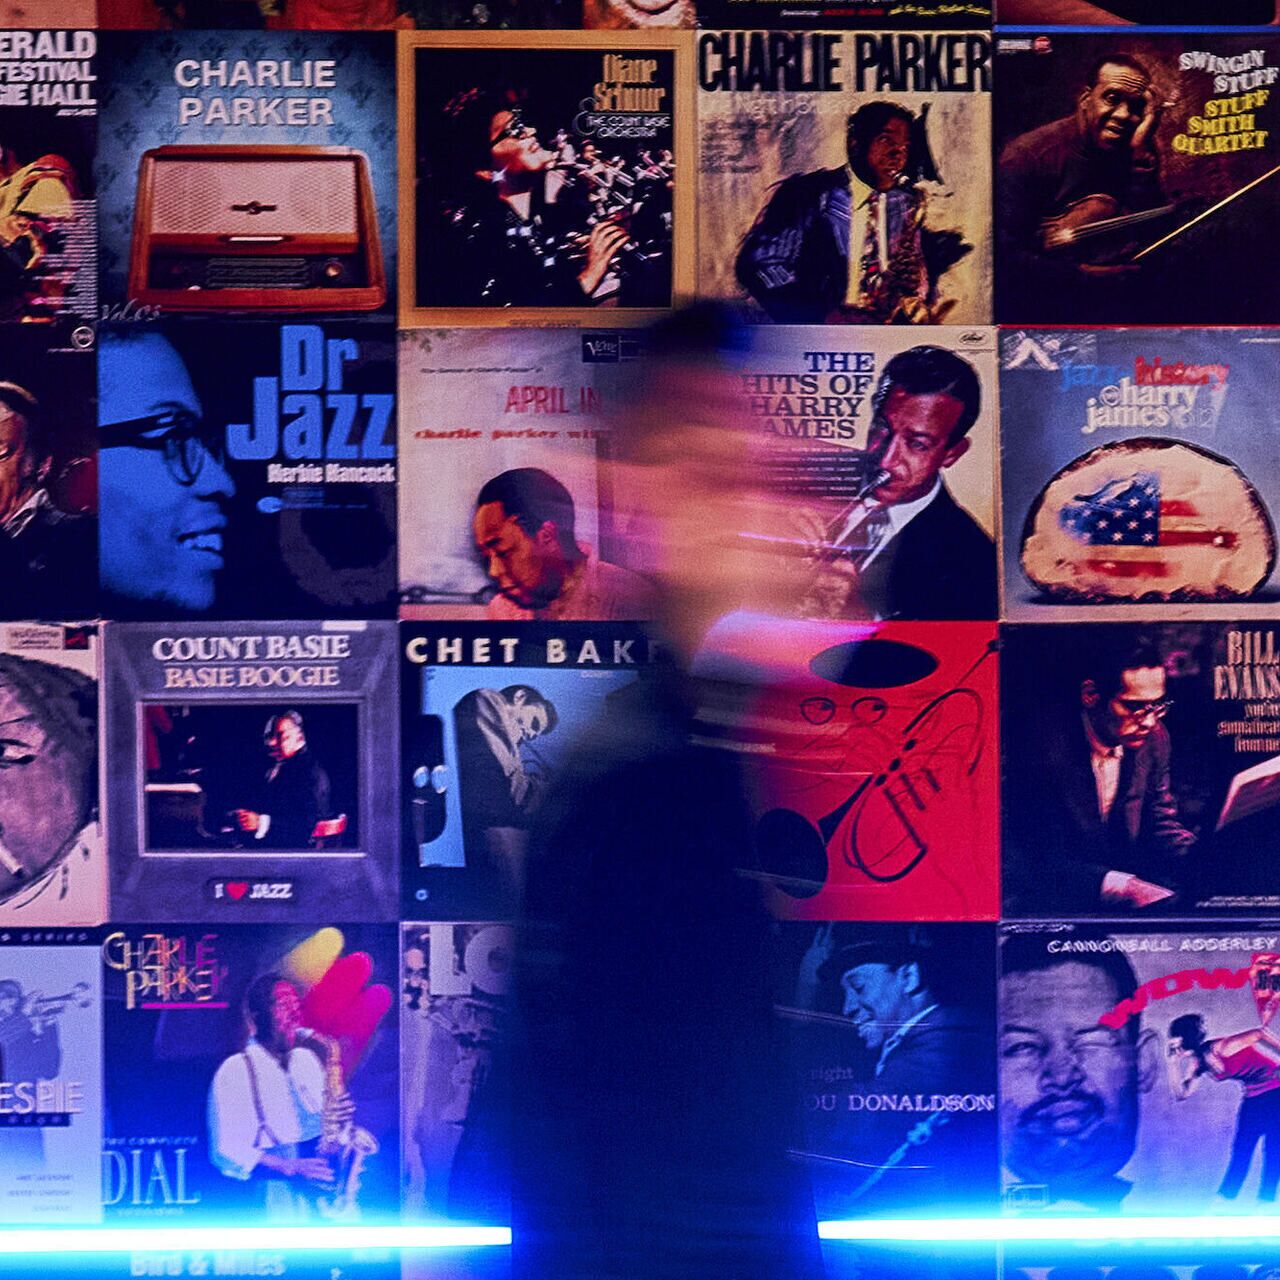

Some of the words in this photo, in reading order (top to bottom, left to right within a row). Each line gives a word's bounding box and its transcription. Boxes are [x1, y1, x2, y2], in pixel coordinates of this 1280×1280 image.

[175, 60, 336, 90] CHARLIE
[699, 33, 842, 92] CHARLIE
[855, 33, 992, 92] PARKER
[1213, 67, 1280, 94] STUFF
[31, 84, 97, 106] HALL
[1204, 90, 1270, 117] STUFF
[179, 97, 336, 126] PARKER
[1187, 114, 1256, 136] SMITH
[1171, 131, 1269, 157] QUARTET
[281, 325, 358, 391] Dr
[803, 352, 875, 373] THE
[741, 374, 819, 395] HITS
[828, 374, 874, 395] OF
[505, 386, 571, 414] APRIL
[750, 396, 865, 417] HARRY
[227, 376, 396, 461] Jazz
[765, 419, 856, 439] AMES
[267, 464, 322, 483] Herbie
[325, 464, 396, 483] Hancock
[152, 635, 263, 662] COUNT
[265, 634, 351, 661] BASIE
[406, 637, 519, 664] CHET
[1227, 631, 1280, 665] BILL
[164, 666, 236, 688] BASIE
[237, 666, 340, 687] BOOGIE
[249, 882, 293, 900] JAZZ
[1047, 938, 1172, 953] CANNONBALL
[1179, 936, 1278, 951] ADDERLEY
[848, 1094, 996, 1112] DONALDSON
[99, 1149, 201, 1205] DIAL
